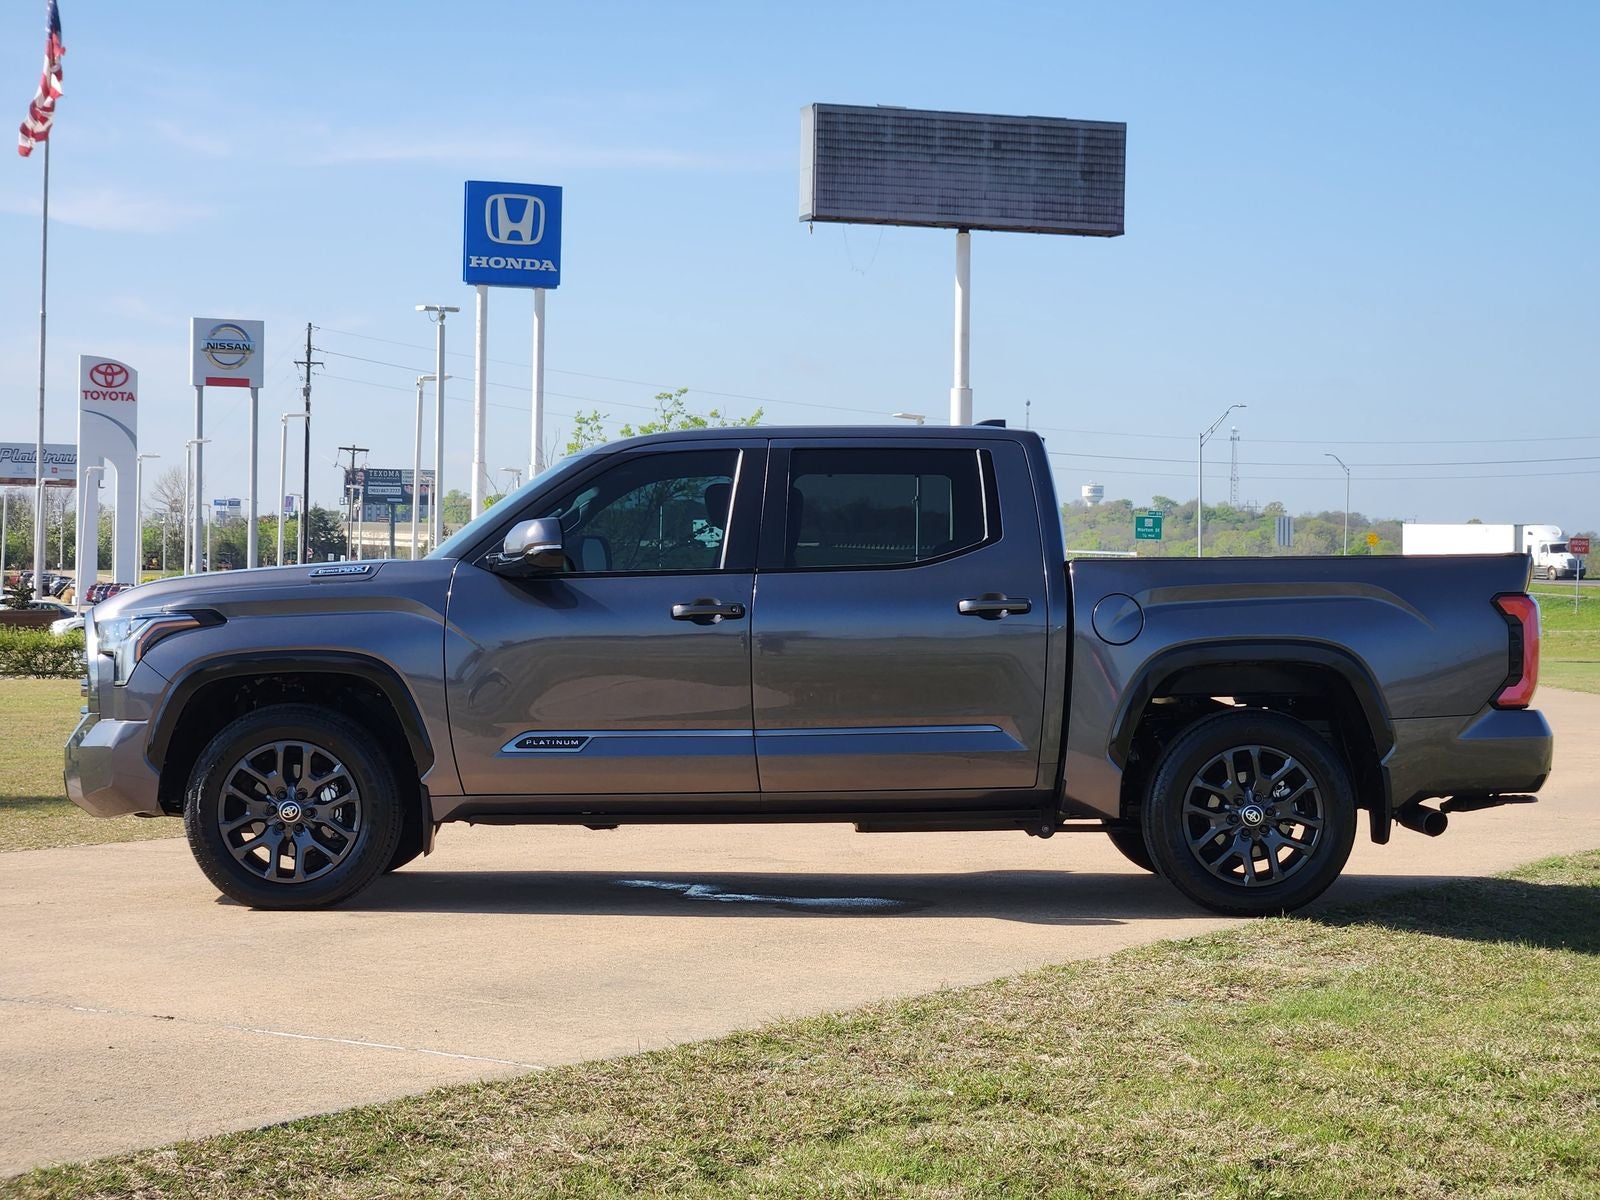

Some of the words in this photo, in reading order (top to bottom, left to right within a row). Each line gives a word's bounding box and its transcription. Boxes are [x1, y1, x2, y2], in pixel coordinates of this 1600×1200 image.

[469, 255, 558, 272] HONDA
[206, 342, 251, 351] NISSAN
[82, 390, 136, 402] TOYOTA
